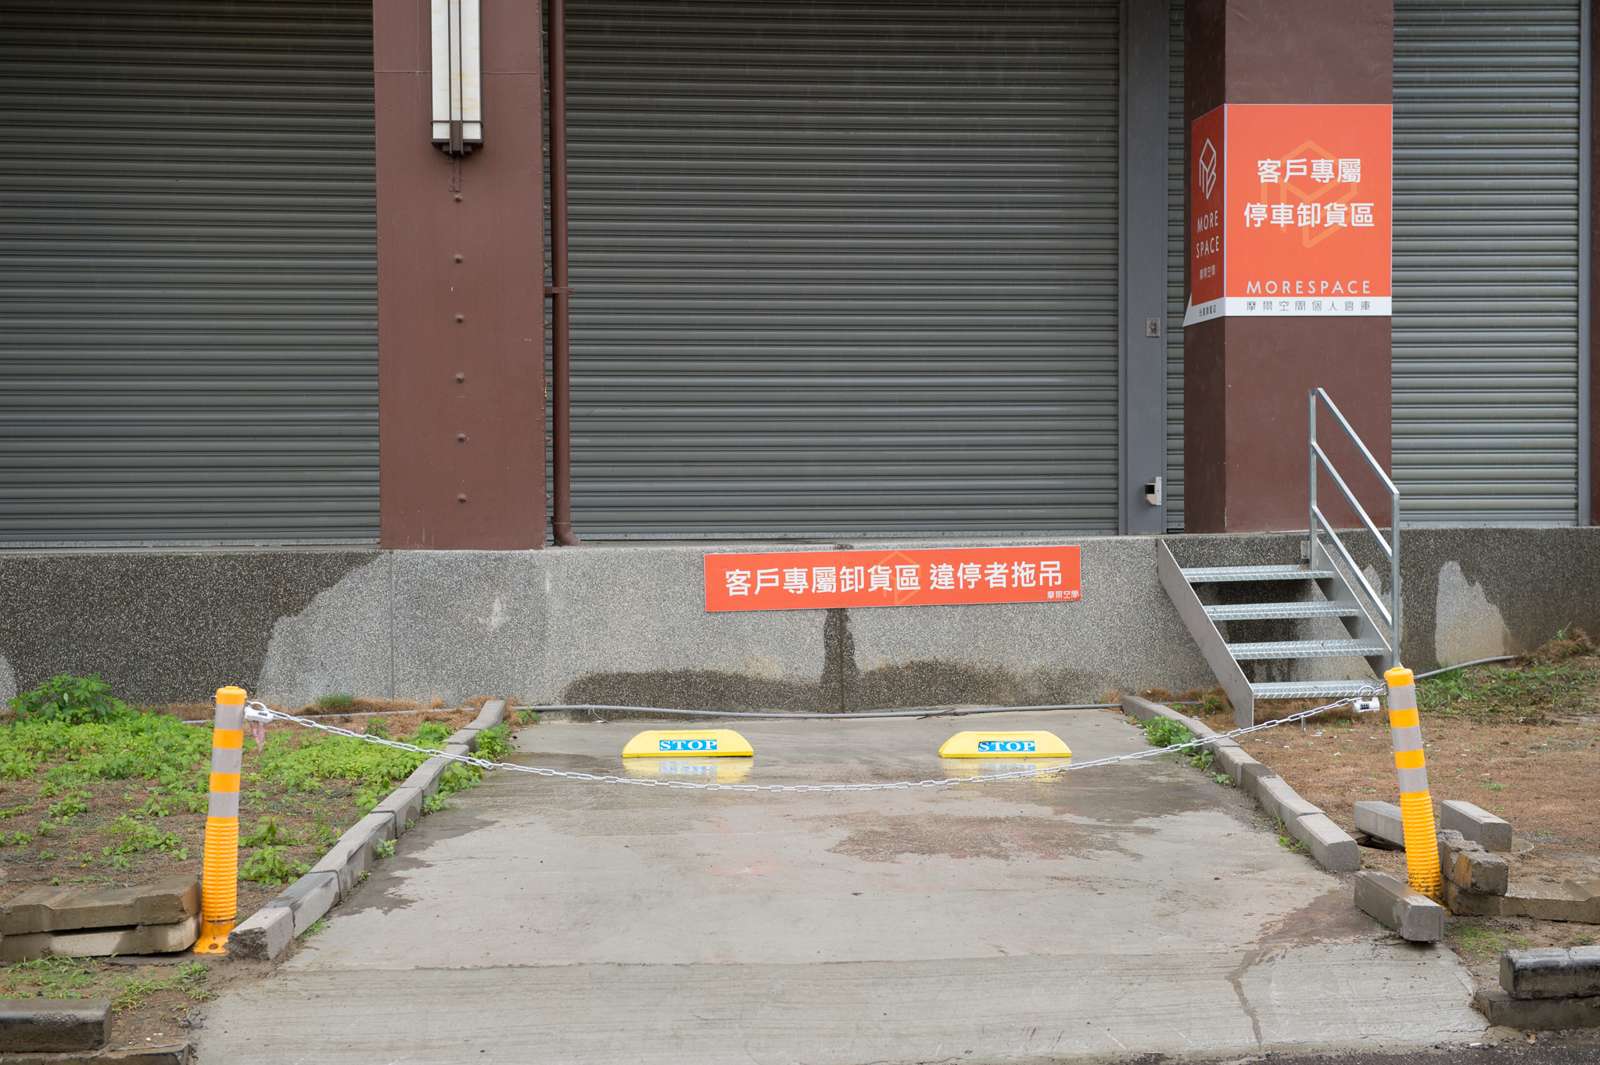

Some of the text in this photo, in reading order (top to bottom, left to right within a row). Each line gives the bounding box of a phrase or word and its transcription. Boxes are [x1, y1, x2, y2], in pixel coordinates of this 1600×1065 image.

[1257, 158, 1361, 184] 客戶專屬
[1197, 210, 1219, 233] MORE
[1244, 202, 1375, 228] 停車卸貨區
[1196, 235, 1219, 259] SPACE
[1247, 280, 1371, 294] MORESPACE
[725, 560, 1063, 597] 客戶專屬卸貨區 違停者拖吊
[659, 739, 717, 751] STOP
[978, 740, 1035, 752] STOP
